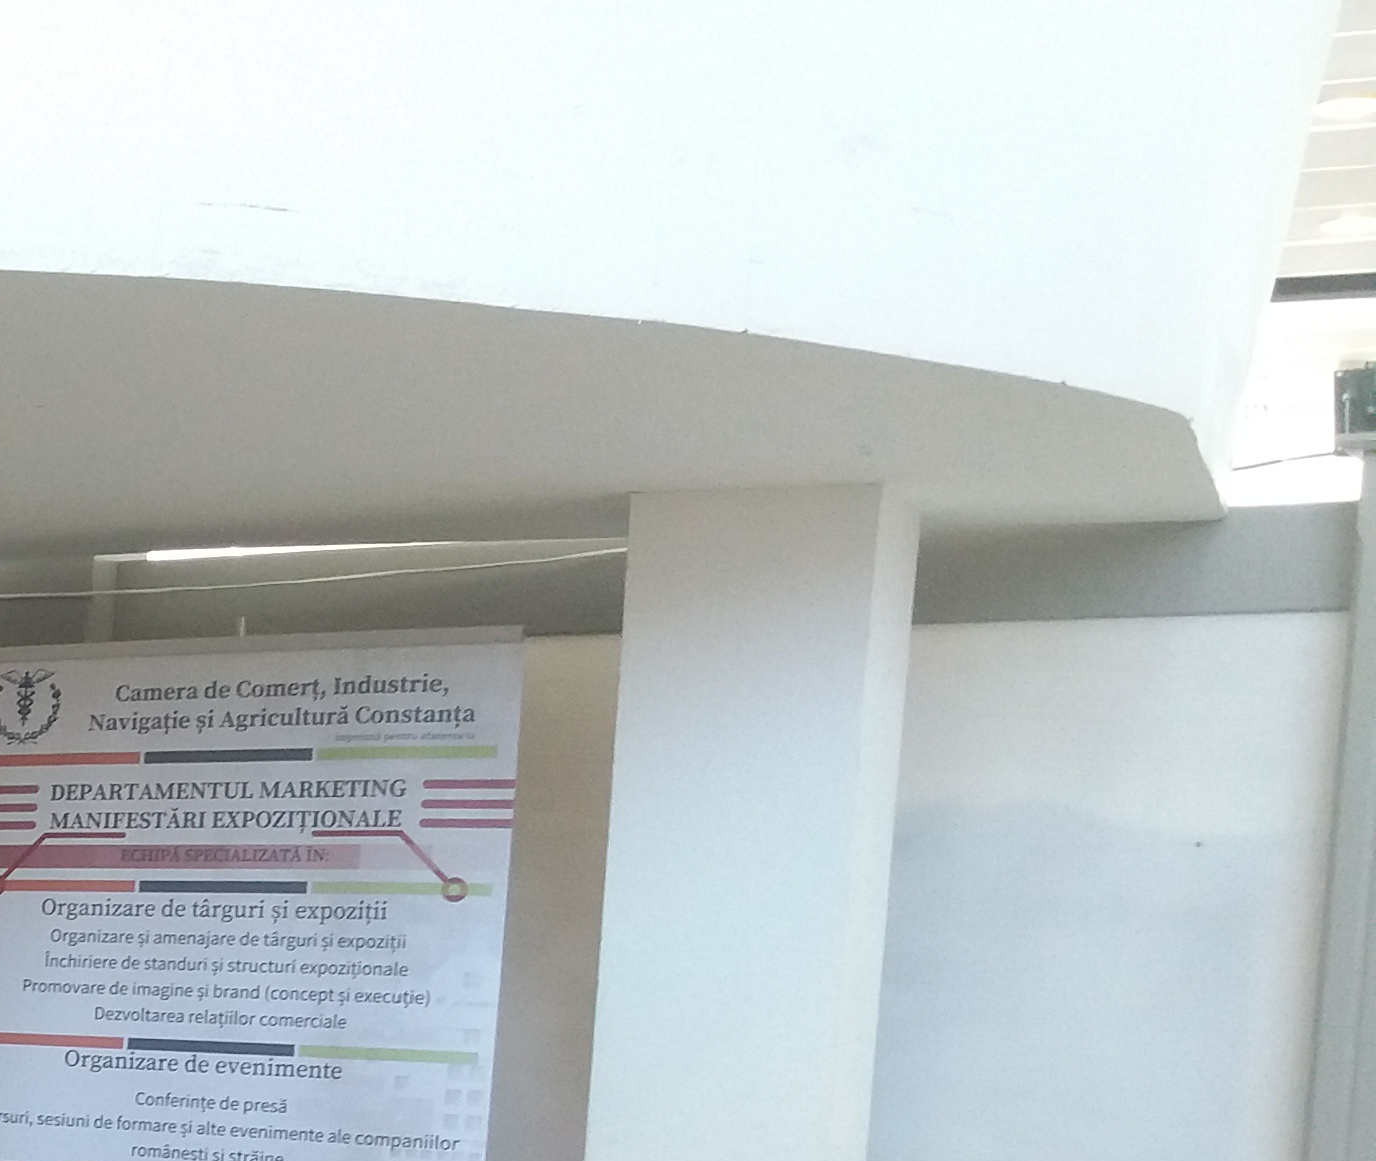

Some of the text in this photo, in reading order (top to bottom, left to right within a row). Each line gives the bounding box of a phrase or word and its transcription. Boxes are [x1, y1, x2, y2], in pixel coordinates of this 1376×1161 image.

[115, 684, 199, 702] Camera
[204, 680, 231, 699] de
[333, 675, 449, 697] Industrie,
[218, 707, 349, 732] Agricultură
[50, 779, 407, 801] DEPARTAMENTUL MARKETING
[49, 811, 207, 830] MANIFESTĂRI
[42, 898, 156, 921] Organizare
[161, 898, 186, 918] de
[192, 898, 265, 923] târguri
[50, 928, 135, 947] Organizare
[153, 930, 236, 950] amenajare
[239, 931, 260, 947] de
[263, 930, 317, 951] târguri
[45, 950, 119, 970] Închiriere
[120, 955, 141, 970] de
[144, 956, 208, 971] standuri
[226, 958, 297, 974] structuri
[94, 1006, 185, 1023] Dezvoltarea
[259, 1013, 347, 1029] comerciale
[64, 1049, 342, 1080] Organizare de evenimente
[219, 1095, 240, 1111] de
[243, 1098, 287, 1115] presă
